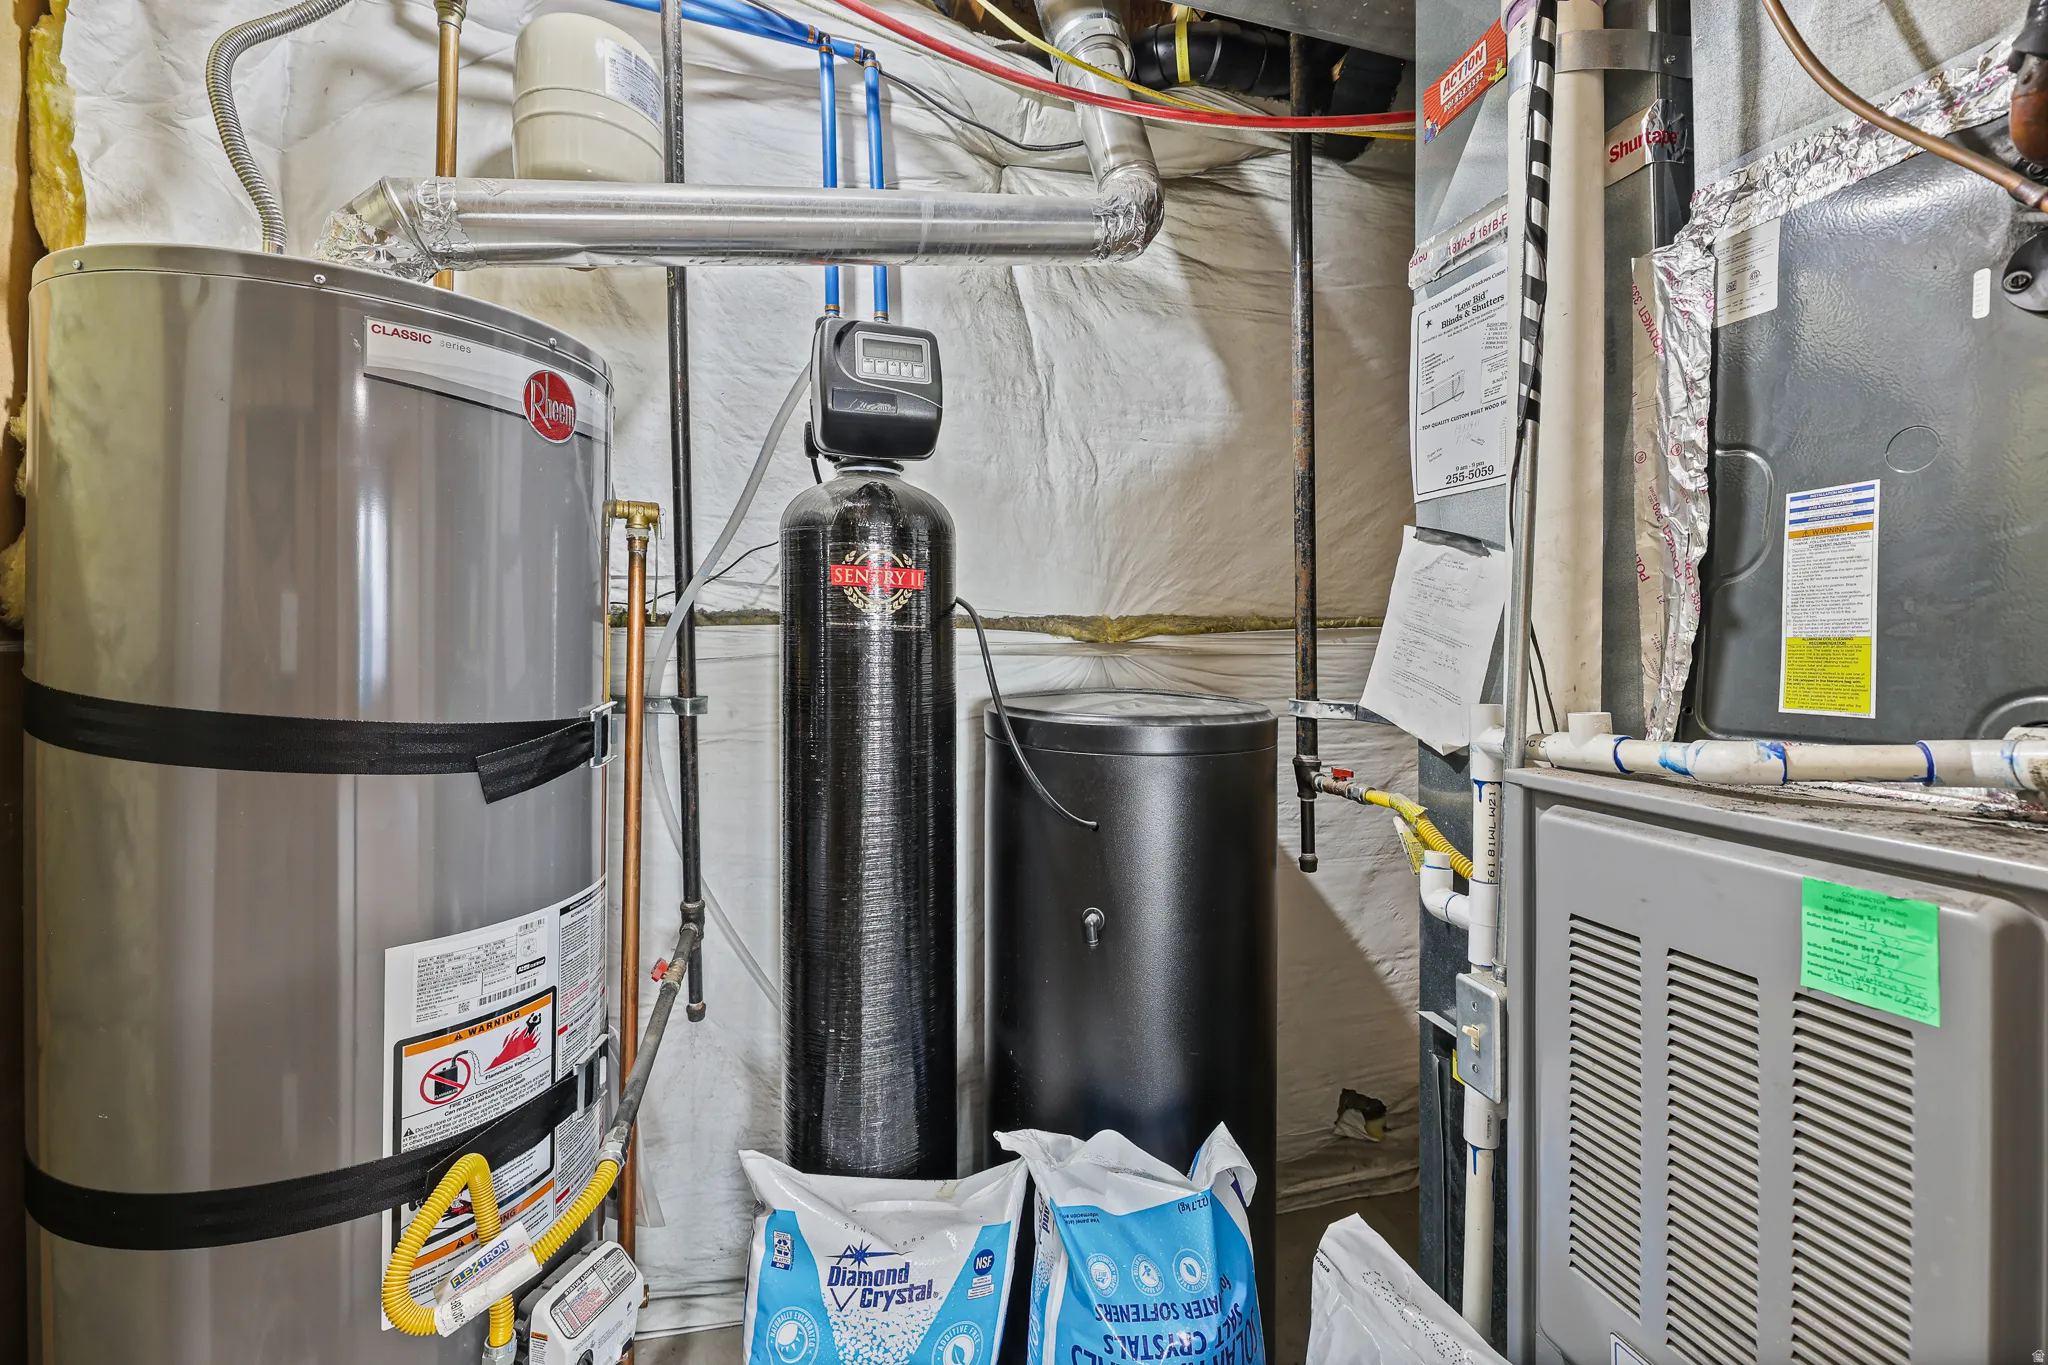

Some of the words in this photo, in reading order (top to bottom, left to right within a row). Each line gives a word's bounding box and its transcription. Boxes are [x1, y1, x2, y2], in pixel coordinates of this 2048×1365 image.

[1609, 128, 1678, 163] Shurtape
[1448, 232, 1475, 255] 181A-P
[1453, 286, 1471, 299] Beautiful
[1471, 277, 1491, 288] Windows
[1492, 269, 1506, 279] Come
[1441, 313, 1462, 329] Blinds
[1472, 294, 1505, 313] Shutters
[371, 324, 432, 344] CLASSIC
[440, 339, 472, 354] series
[531, 372, 575, 430] Rheem
[1432, 418, 1450, 428] QUALITY
[1451, 412, 1470, 422] CUSTOM
[1471, 408, 1483, 416] BUILT
[1484, 403, 1500, 411] WOOD
[1445, 464, 1494, 485] 255-5059
[1813, 526, 1847, 535] WARNING
[834, 568, 907, 586] SENTRY
[911, 572, 921, 586] II
[1488, 792, 1497, 817] W21
[1842, 892, 1886, 904] CONTRACTOR
[1824, 905, 1864, 920] Beginning
[1884, 919, 1907, 929] Point
[1832, 938, 1858, 950] Ending
[1878, 948, 1900, 959] Point
[468, 1011, 520, 1035] WARNING
[486, 1065, 513, 1080] Flammable
[515, 1057, 530, 1067] Vapors
[449, 1101, 461, 1109] FIRE
[476, 1083, 503, 1099] EXPLOSION
[504, 1074, 522, 1086] HAZARD
[457, 1103, 470, 1112] result
[478, 1093, 495, 1103] serious
[514, 1078, 526, 1086] death
[433, 1119, 446, 1127] store
[463, 1106, 483, 1117] gasoline
[409, 1137, 422, 1146] other
[424, 1128, 450, 1140] flammable
[451, 1122, 467, 1131] vapors
[418, 1128, 435, 1138] vicinity
[1178, 1202, 1190, 1213] kg)
[895, 1236, 924, 1247] 1886
[827, 1262, 910, 1286] Diamond
[976, 1256, 992, 1269] NSF
[564, 1280, 581, 1295] STATUS
[581, 1268, 594, 1280] LIGHT
[594, 1257, 606, 1268] CODE
[860, 1279, 933, 1312] Crystal
[1182, 1292, 1223, 1319] ATER
[1095, 1302, 1180, 1322] SOFTENERS
[770, 1312, 793, 1337] NATURALLY
[794, 1312, 816, 1347] EVAPORATED
[1215, 1302, 1242, 1349] SALT
[938, 1325, 968, 1351] ADDITIVE
[969, 1327, 980, 1344] FREE
[1103, 1331, 1207, 1361] CRYSTALS
